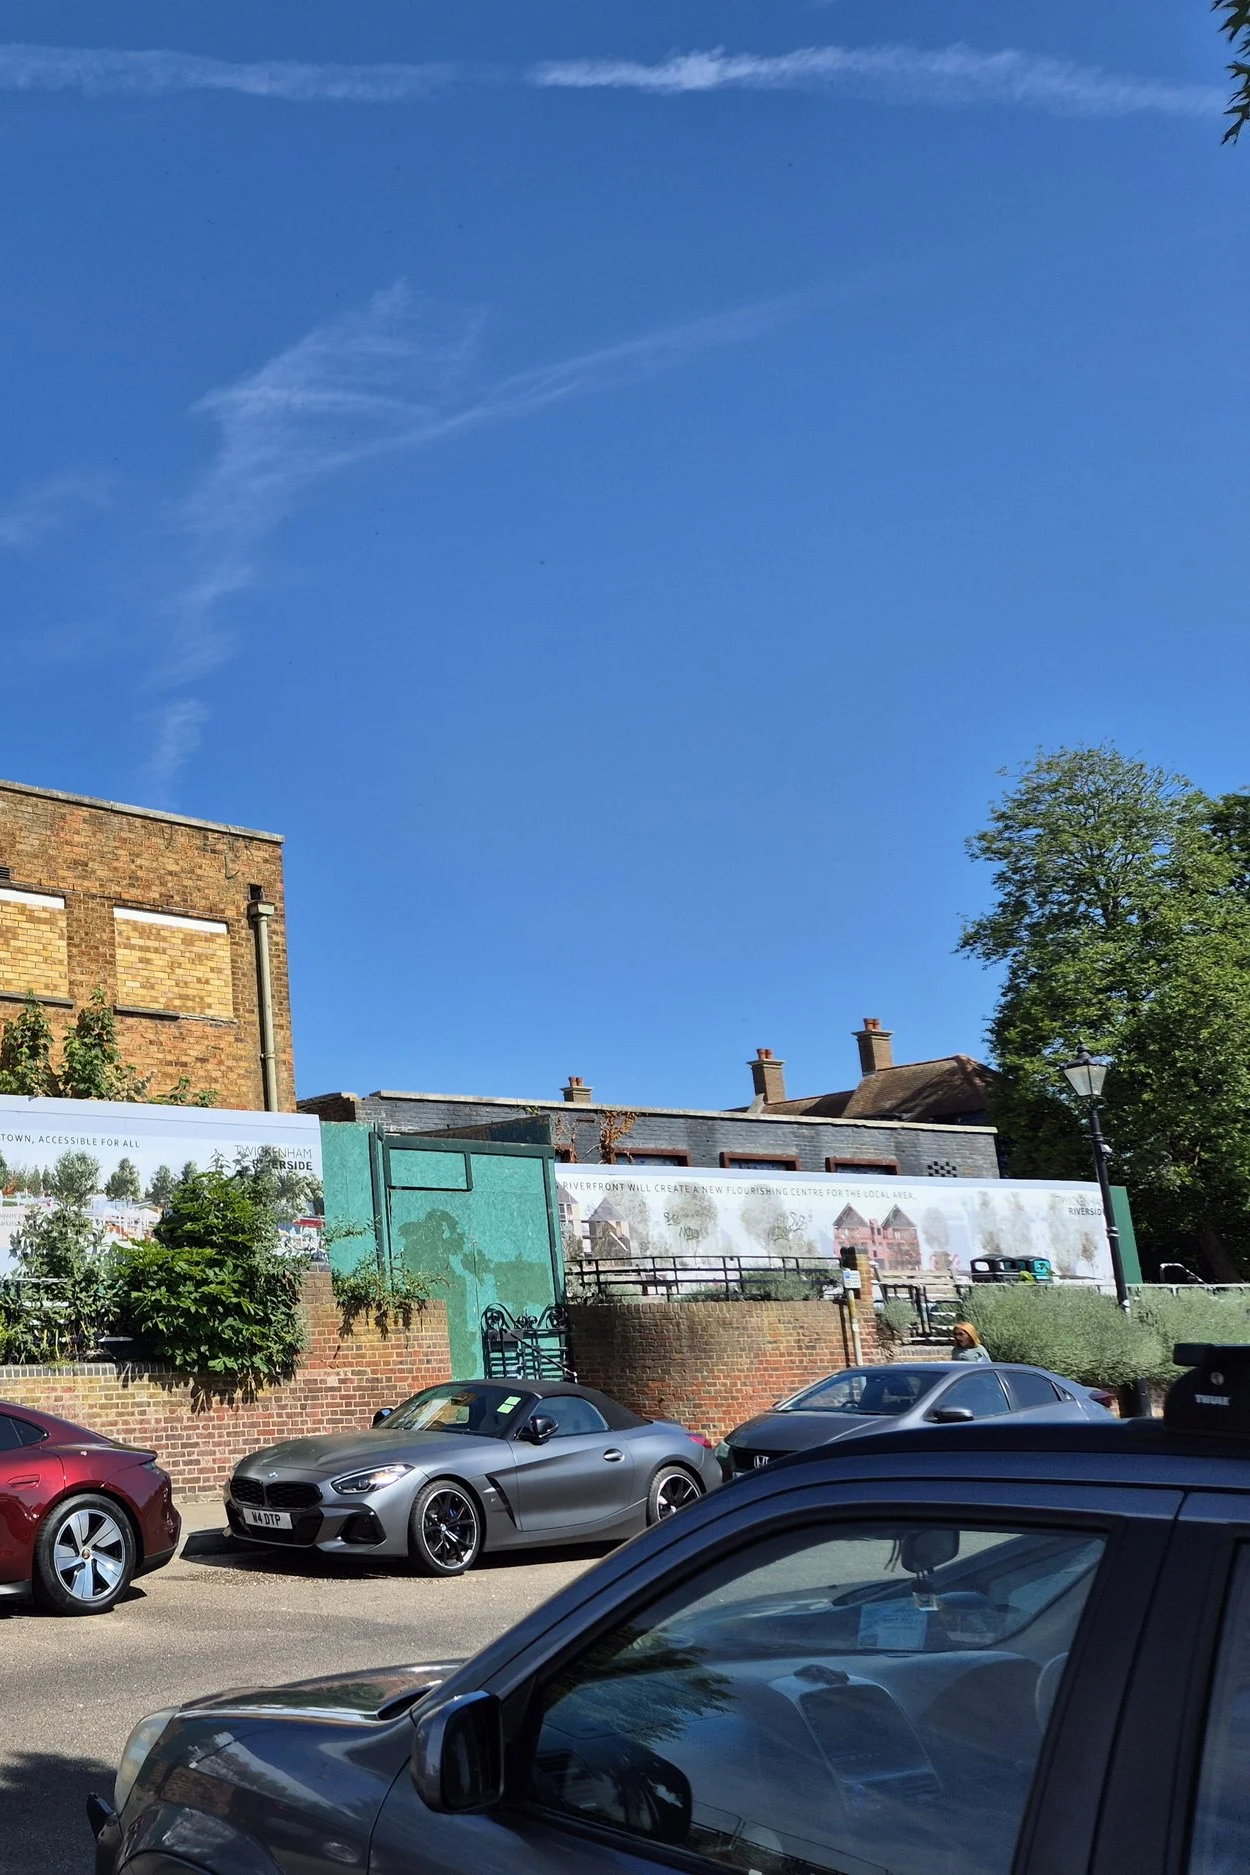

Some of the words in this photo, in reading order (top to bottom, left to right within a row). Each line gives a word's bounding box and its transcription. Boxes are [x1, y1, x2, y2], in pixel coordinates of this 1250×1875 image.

[0, 1133, 36, 1145] TOWN,
[38, 1135, 98, 1147] ACCESSIBLE
[101, 1138, 119, 1148] FOR
[122, 1139, 140, 1148] ALL
[252, 1159, 313, 1171] RERSIDE
[562, 1181, 625, 1192] RIVERFRONT
[628, 1183, 652, 1193] WILL
[654, 1184, 691, 1194] CREATE
[693, 1184, 700, 1193] A
[701, 1186, 724, 1195] NEW
[726, 1186, 788, 1196] FLOURISHING
[790, 1187, 823, 1197] CENTRE
[826, 1188, 843, 1198] FOR
[844, 1189, 863, 1198] THE
[864, 1189, 891, 1199] LOCAL
[1068, 1207, 1102, 1216] RIVERSID
[264, 1512, 281, 1526] DTP
